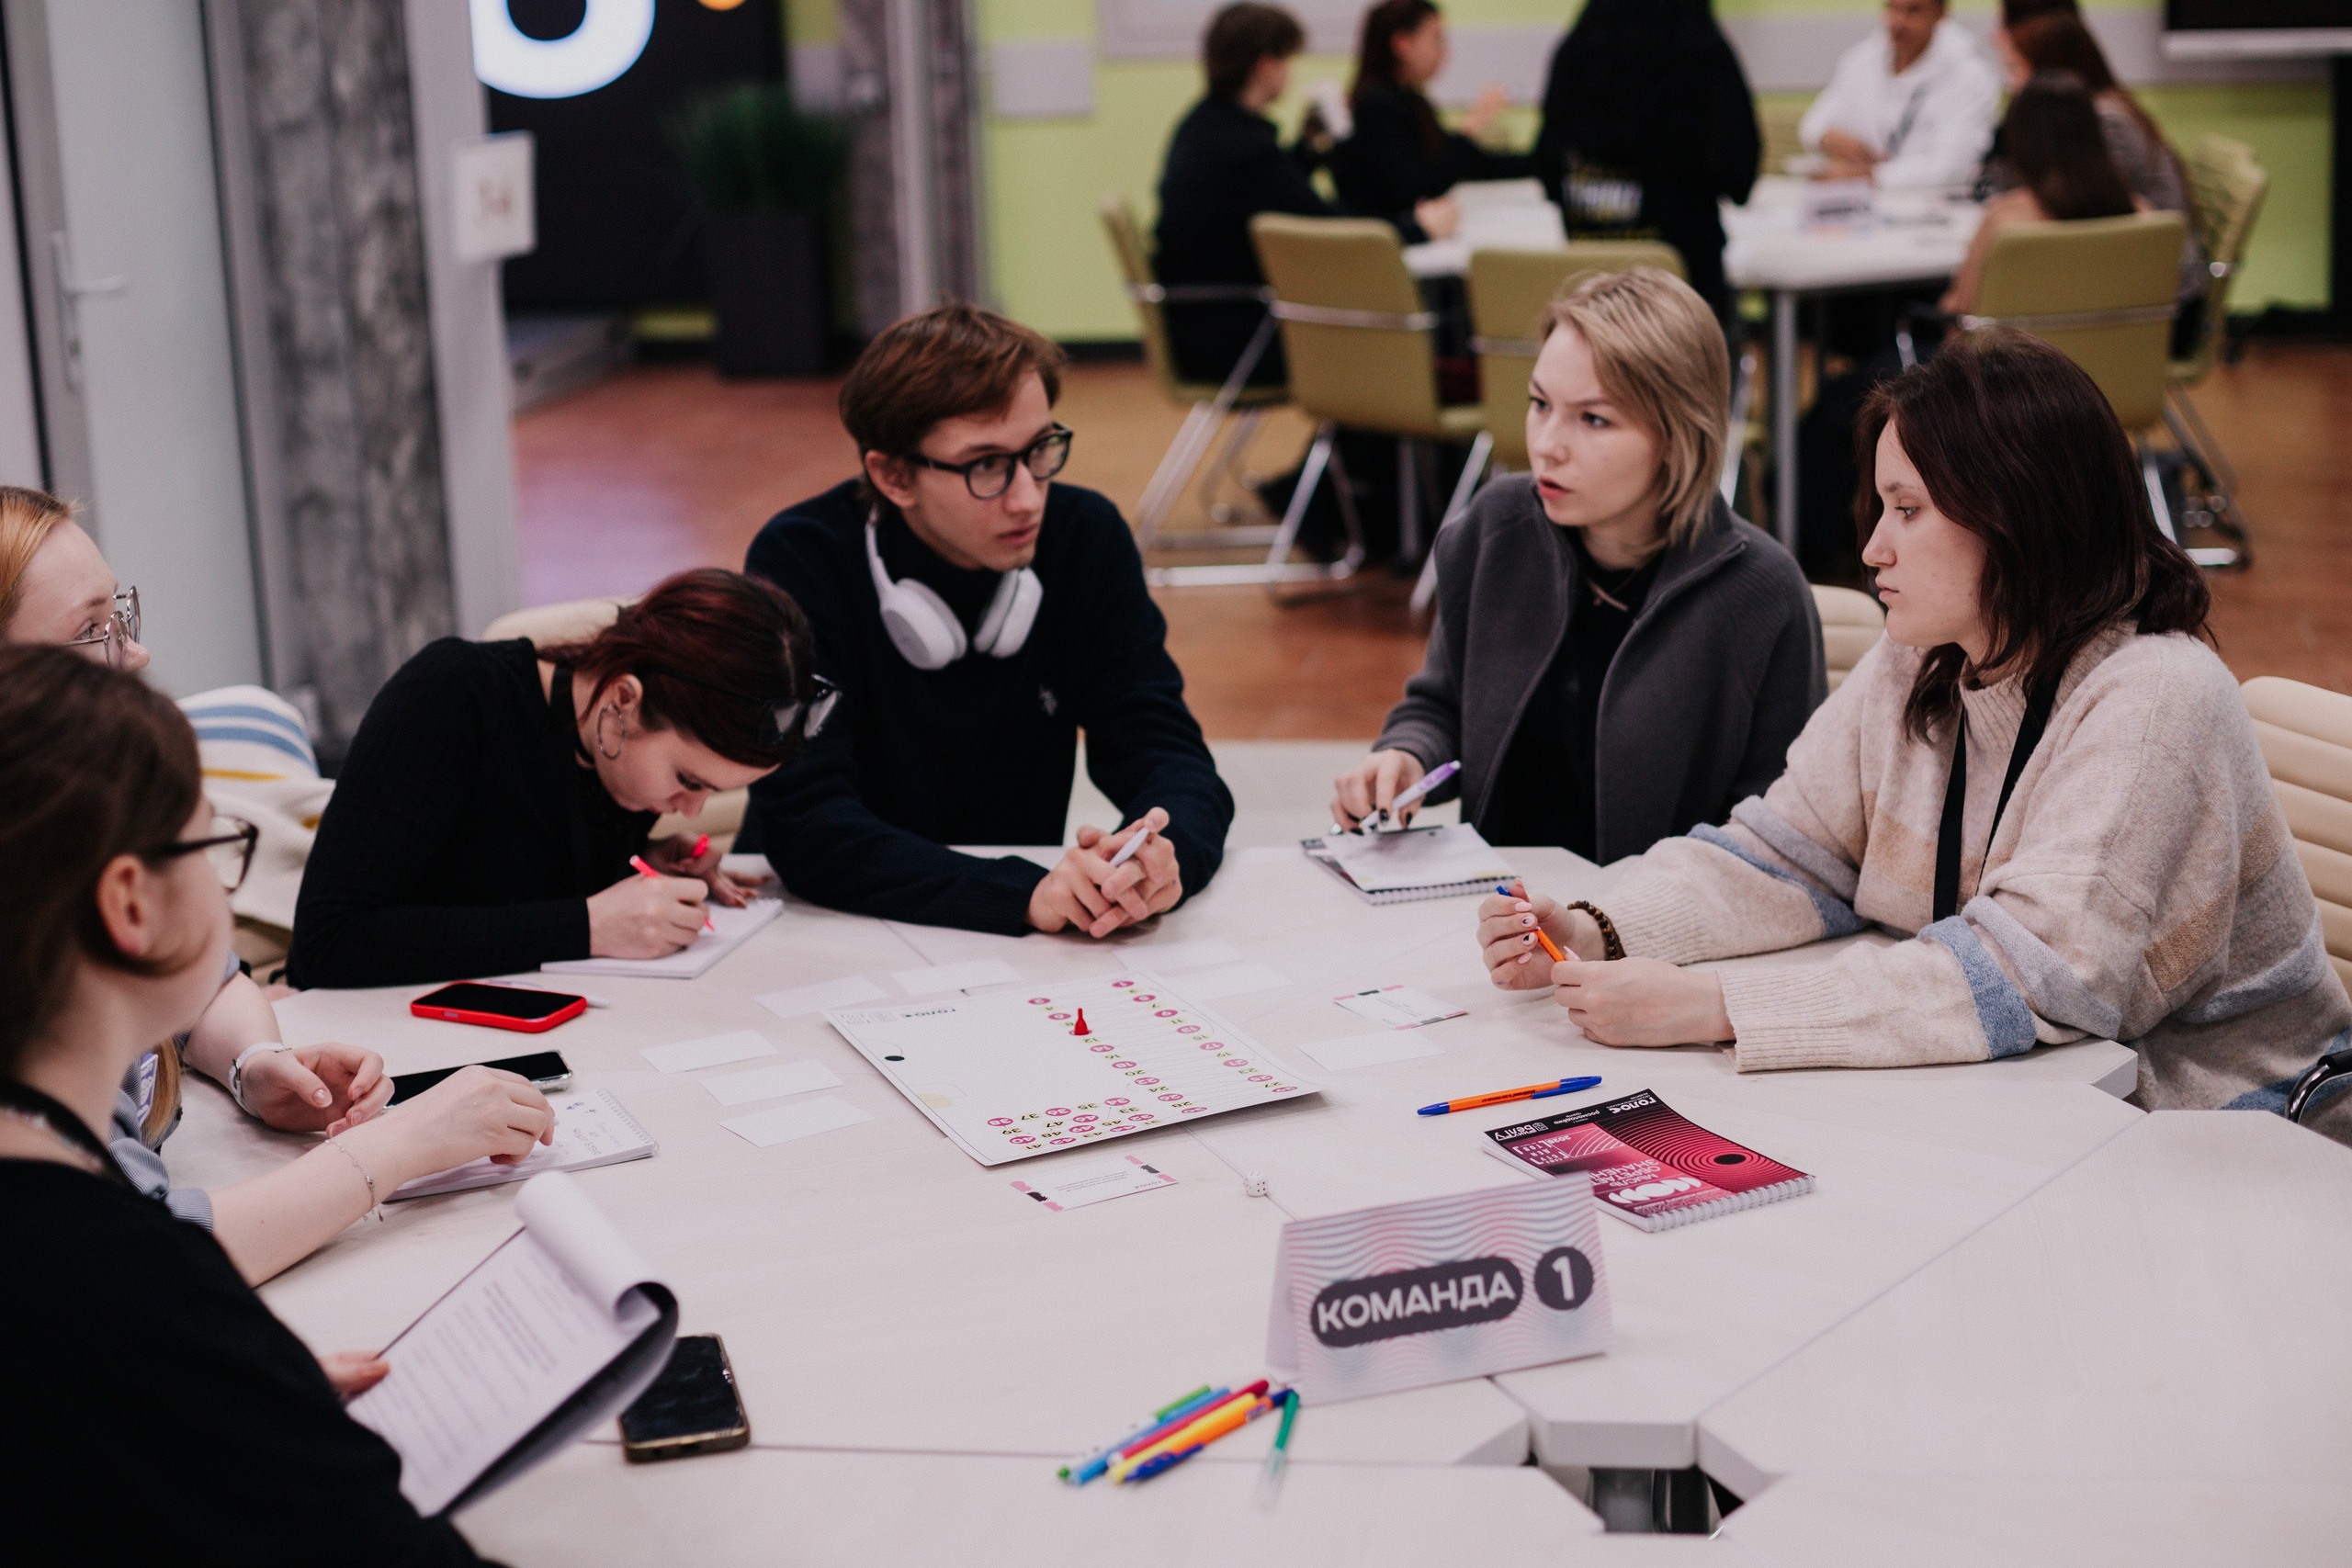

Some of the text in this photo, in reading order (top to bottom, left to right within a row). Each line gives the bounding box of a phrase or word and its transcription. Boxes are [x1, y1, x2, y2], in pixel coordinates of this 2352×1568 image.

[1590, 1166, 1660, 1186] ОБРЕТАЕТ
[1610, 1174, 1658, 1187] МЫСЛЬ
[1317, 1256, 1576, 1333] КОМАНДА 1
